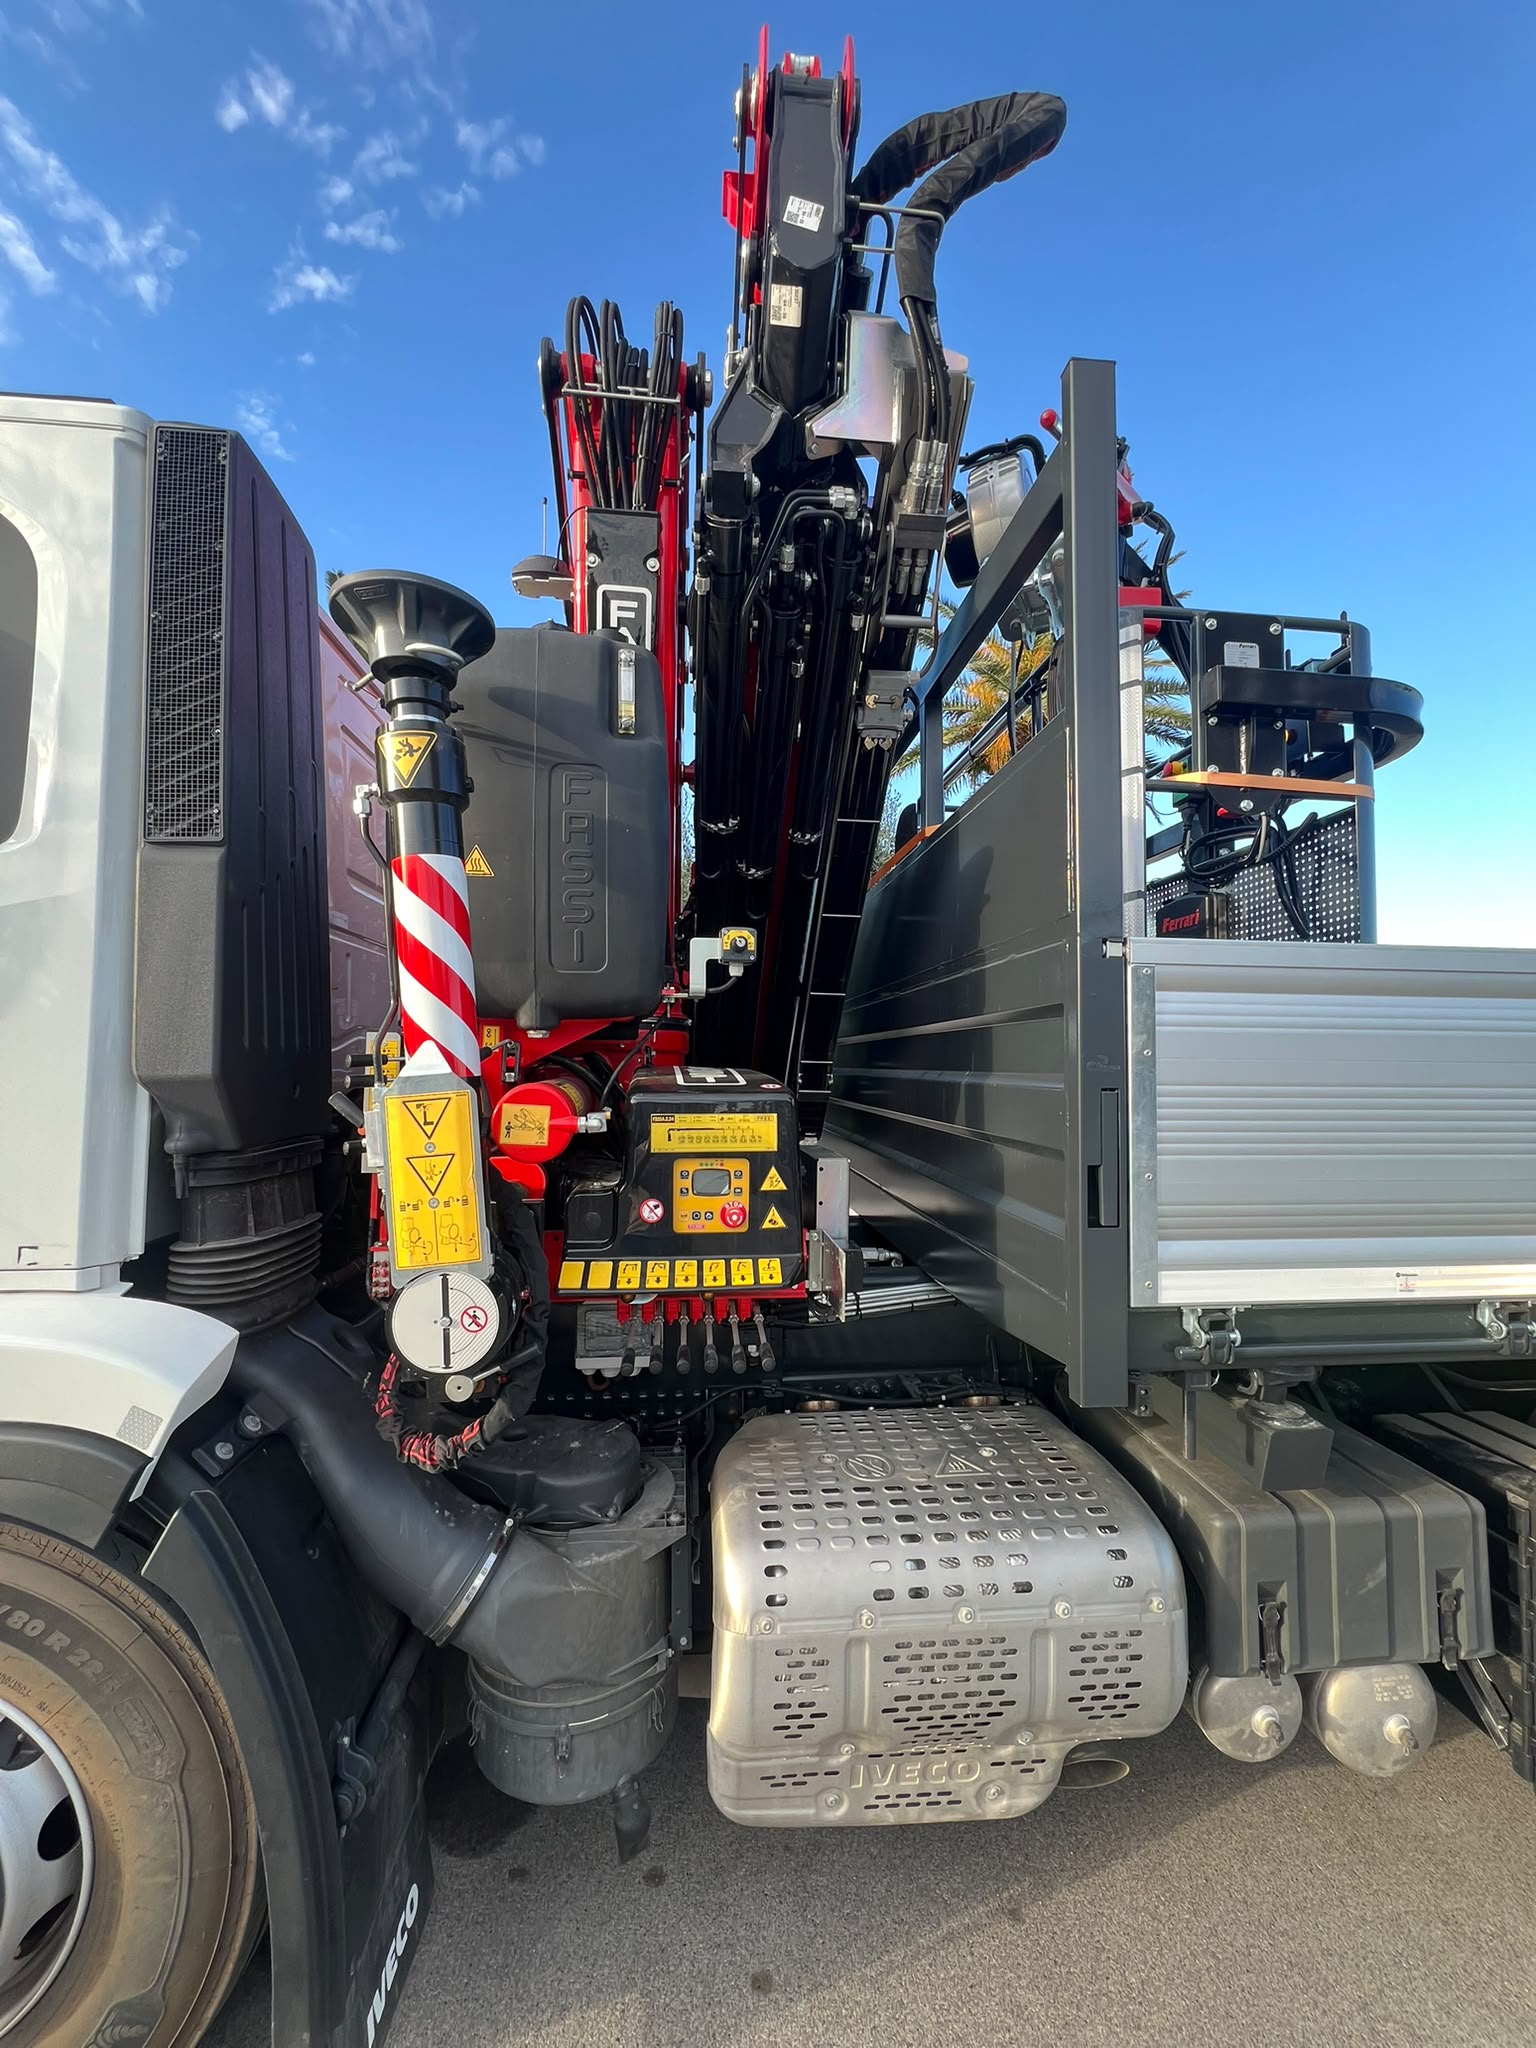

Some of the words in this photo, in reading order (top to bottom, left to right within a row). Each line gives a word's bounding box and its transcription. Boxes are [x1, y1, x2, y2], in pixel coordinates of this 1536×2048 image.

[562, 771, 594, 964] FASSI
[1161, 908, 1200, 934] Ferrari
[724, 1200, 743, 1209] STOP
[43, 1630, 71, 1654] R
[851, 1760, 981, 1789] IVECO
[366, 1883, 419, 2048] IVECO
